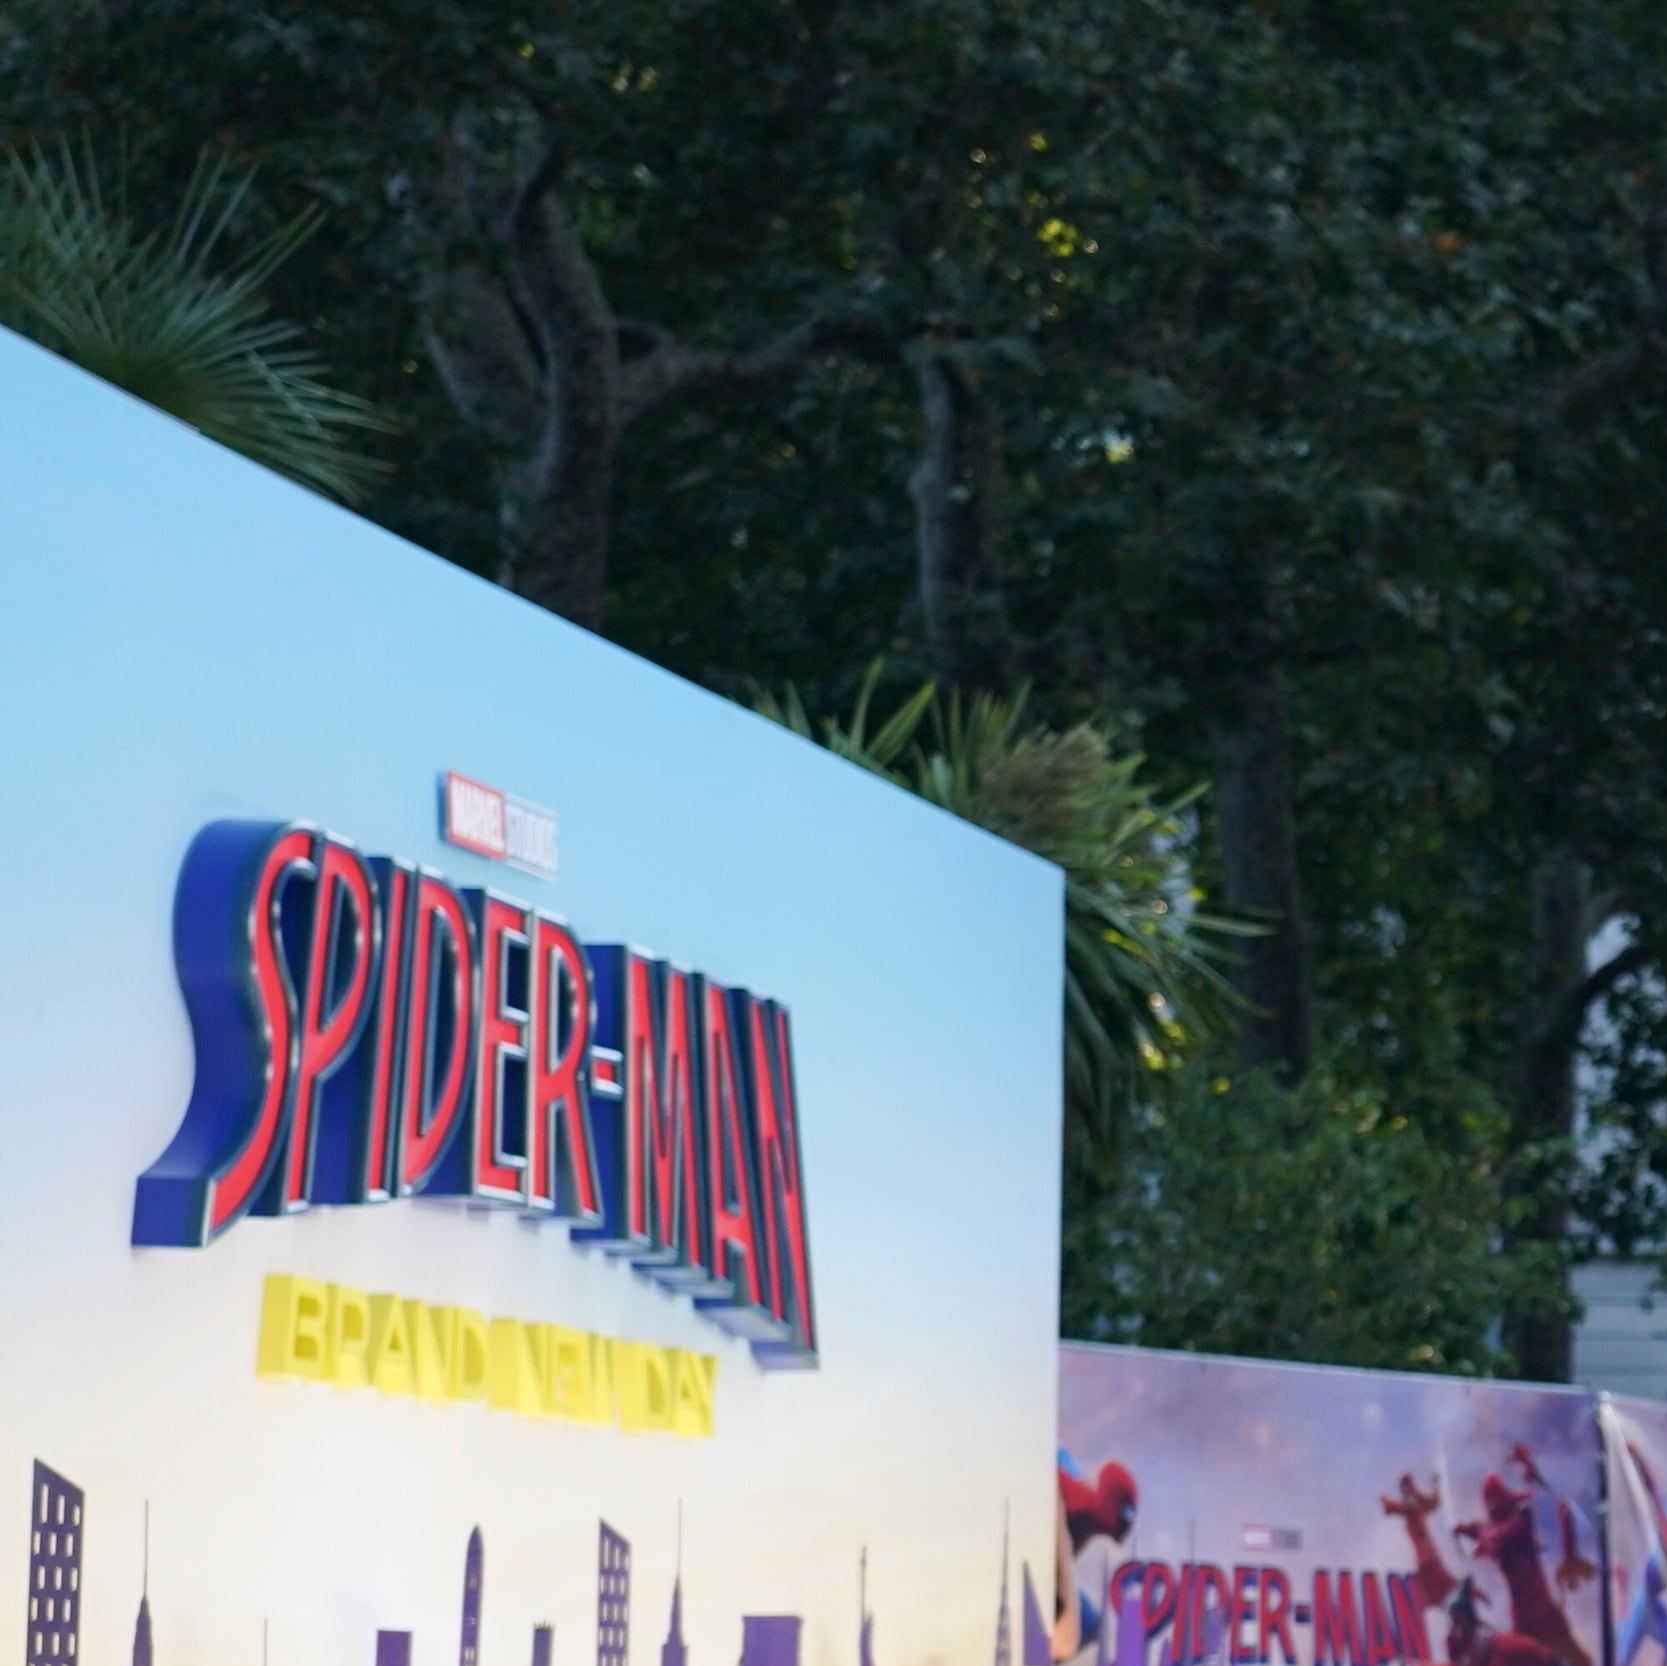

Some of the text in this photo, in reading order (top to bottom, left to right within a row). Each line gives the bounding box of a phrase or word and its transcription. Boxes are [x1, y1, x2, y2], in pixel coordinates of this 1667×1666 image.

[132, 820, 818, 1370] SPIDER-MAN
[257, 1275, 719, 1437] BRAND NEW DAY
